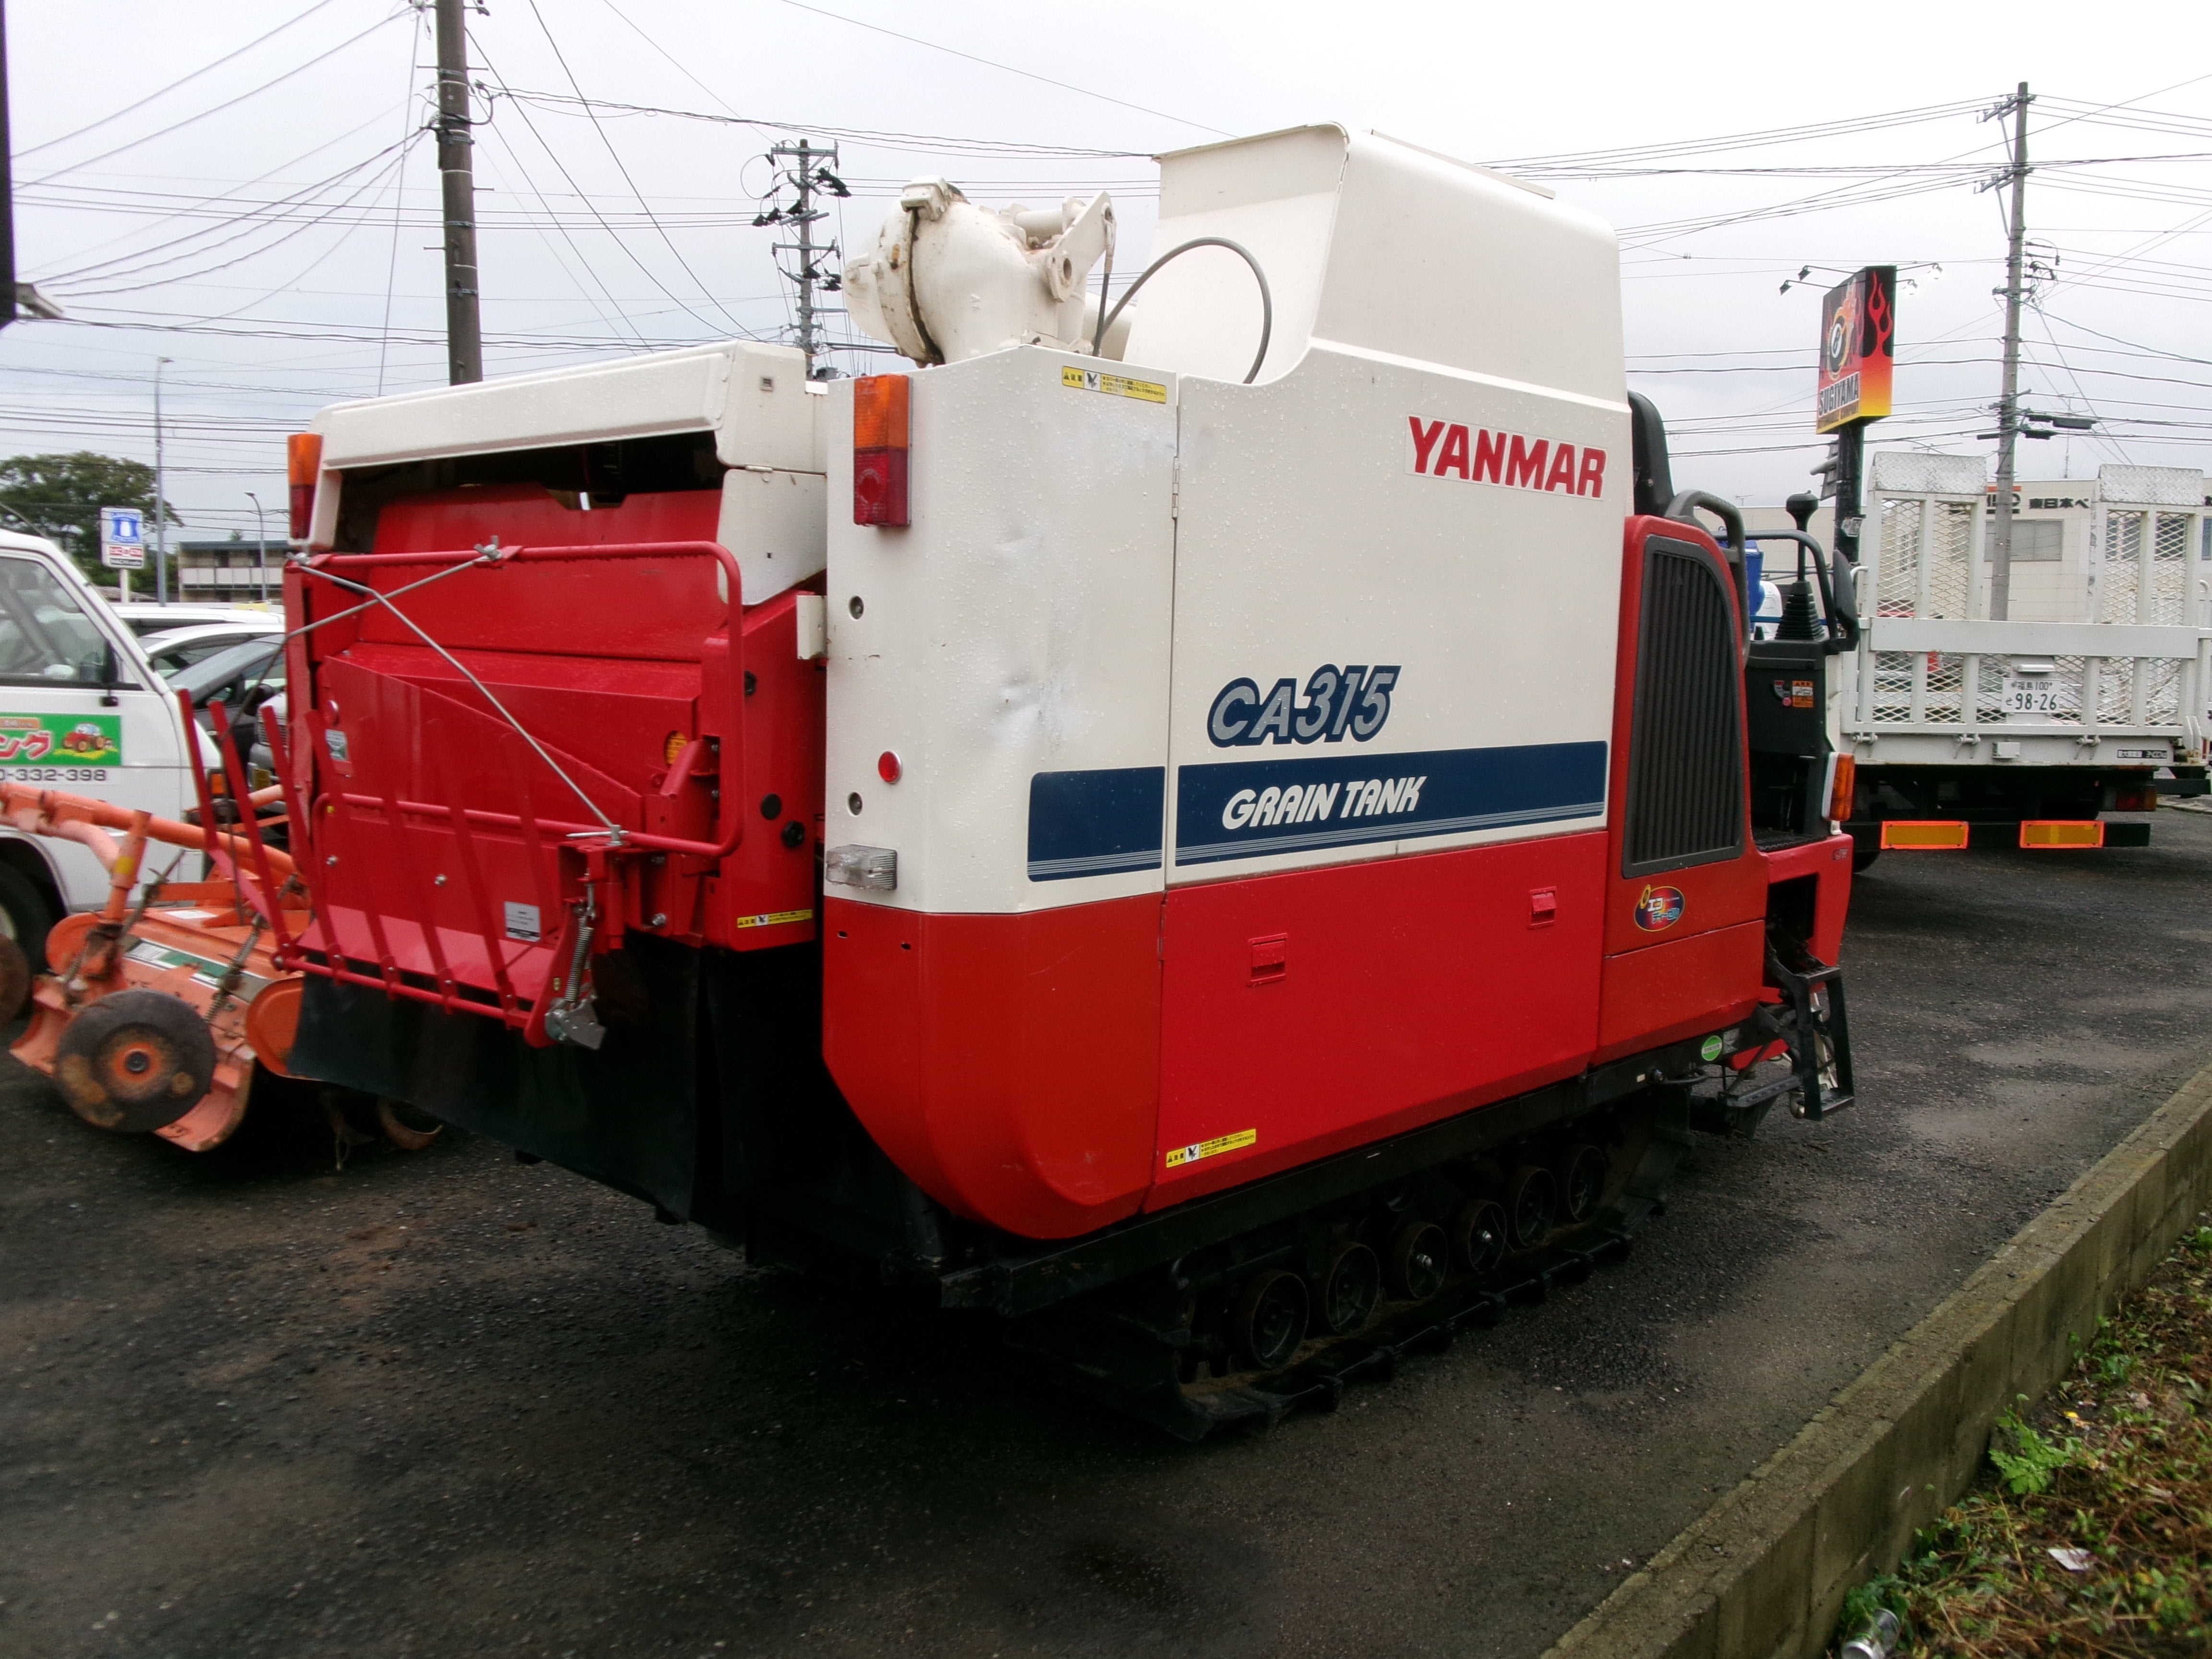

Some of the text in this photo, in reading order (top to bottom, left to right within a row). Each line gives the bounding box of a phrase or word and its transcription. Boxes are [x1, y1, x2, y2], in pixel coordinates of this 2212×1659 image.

[1818, 372, 1859, 417] SUGIYAMA
[1408, 416, 1606, 498] YANMAR
[1206, 663, 1402, 748] CA315
[2015, 693, 2058, 710] 98-26
[2035, 681, 2049, 690] 100
[1222, 775, 1428, 830] GRAIN TANK
